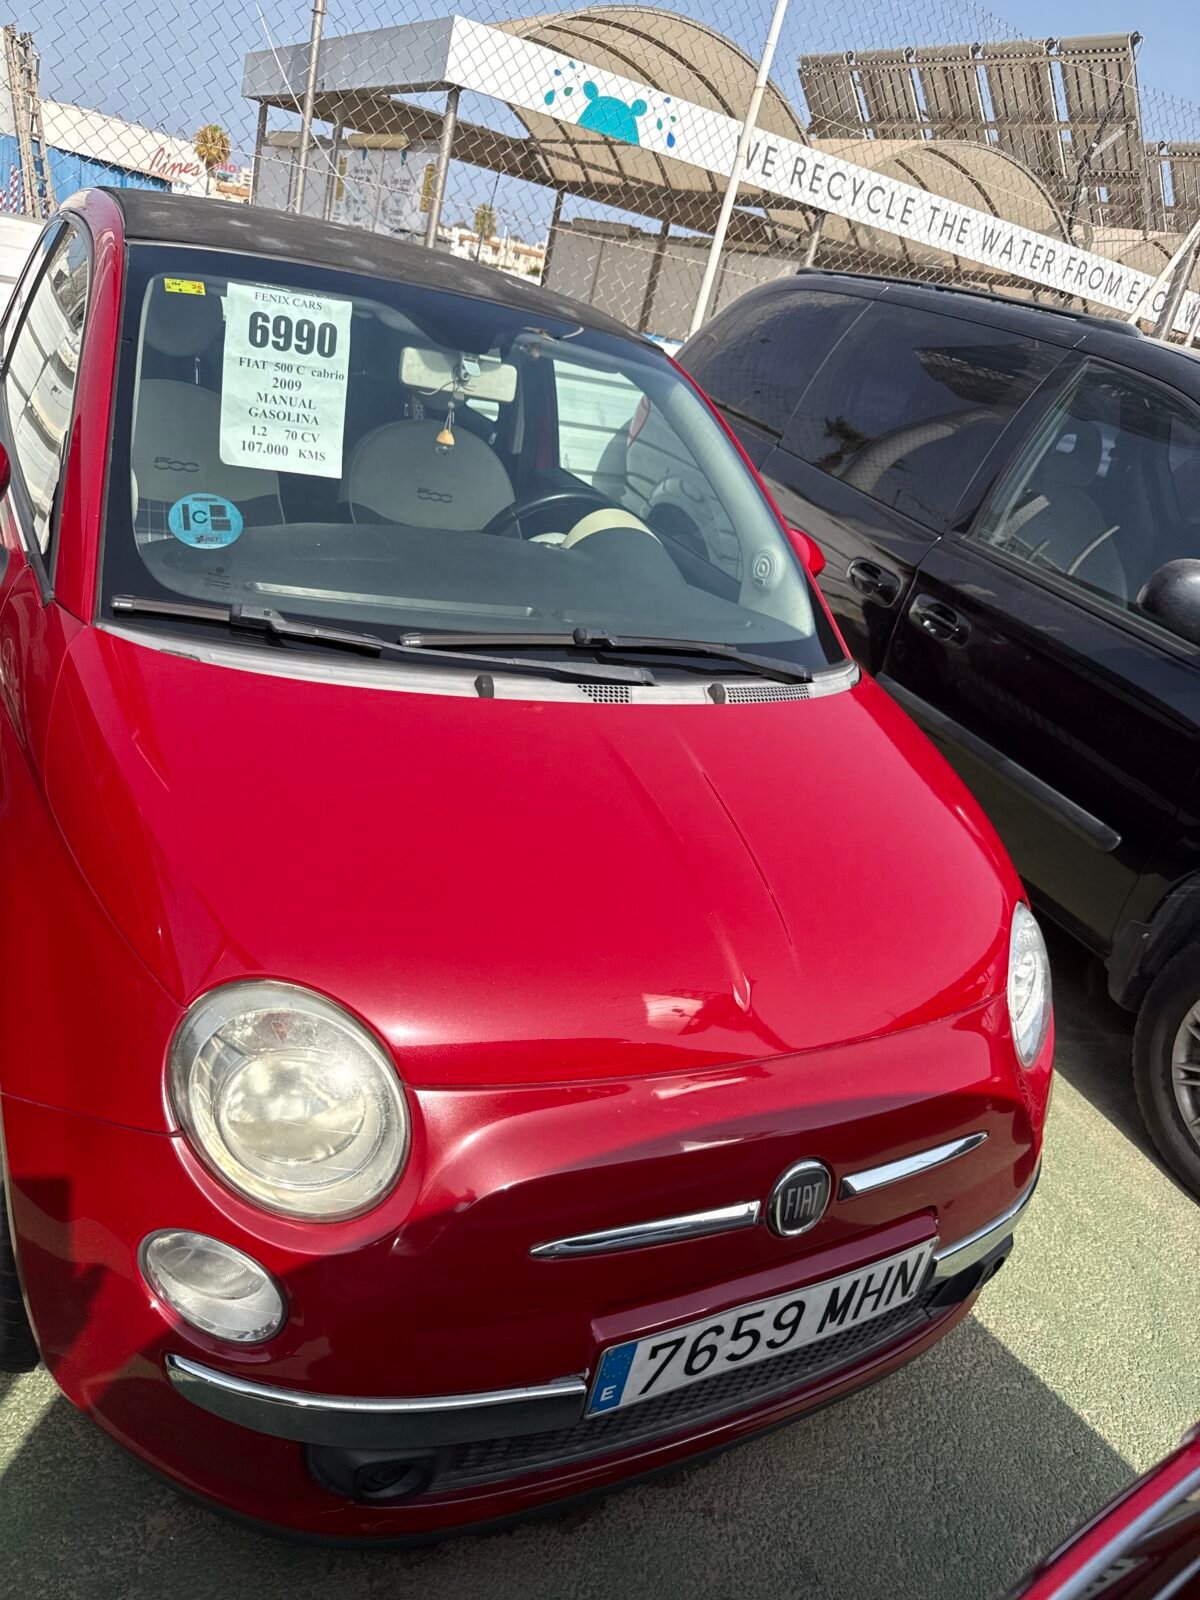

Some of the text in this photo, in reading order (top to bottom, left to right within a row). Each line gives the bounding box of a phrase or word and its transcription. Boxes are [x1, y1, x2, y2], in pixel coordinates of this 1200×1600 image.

[790, 156, 915, 225] RECYCLE
[927, 205, 970, 245] THE
[981, 225, 1056, 274] WATER
[1062, 256, 1123, 298] FROM
[254, 291, 323, 311] FENIX CARS
[248, 311, 338, 358] 6990
[239, 356, 345, 381] FIAT 500 C cabrio
[272, 377, 302, 391] 2009
[256, 391, 317, 410] MANUAL
[248, 406, 320, 426] GASOLINA
[251, 425, 320, 443] 1.2 70 CV
[241, 440, 326, 462] 107.000 KMS
[192, 510, 208, 524] C
[782, 1180, 823, 1222] FIAT
[638, 1251, 925, 1396] 7659 MHN
[599, 1384, 617, 1401] E
